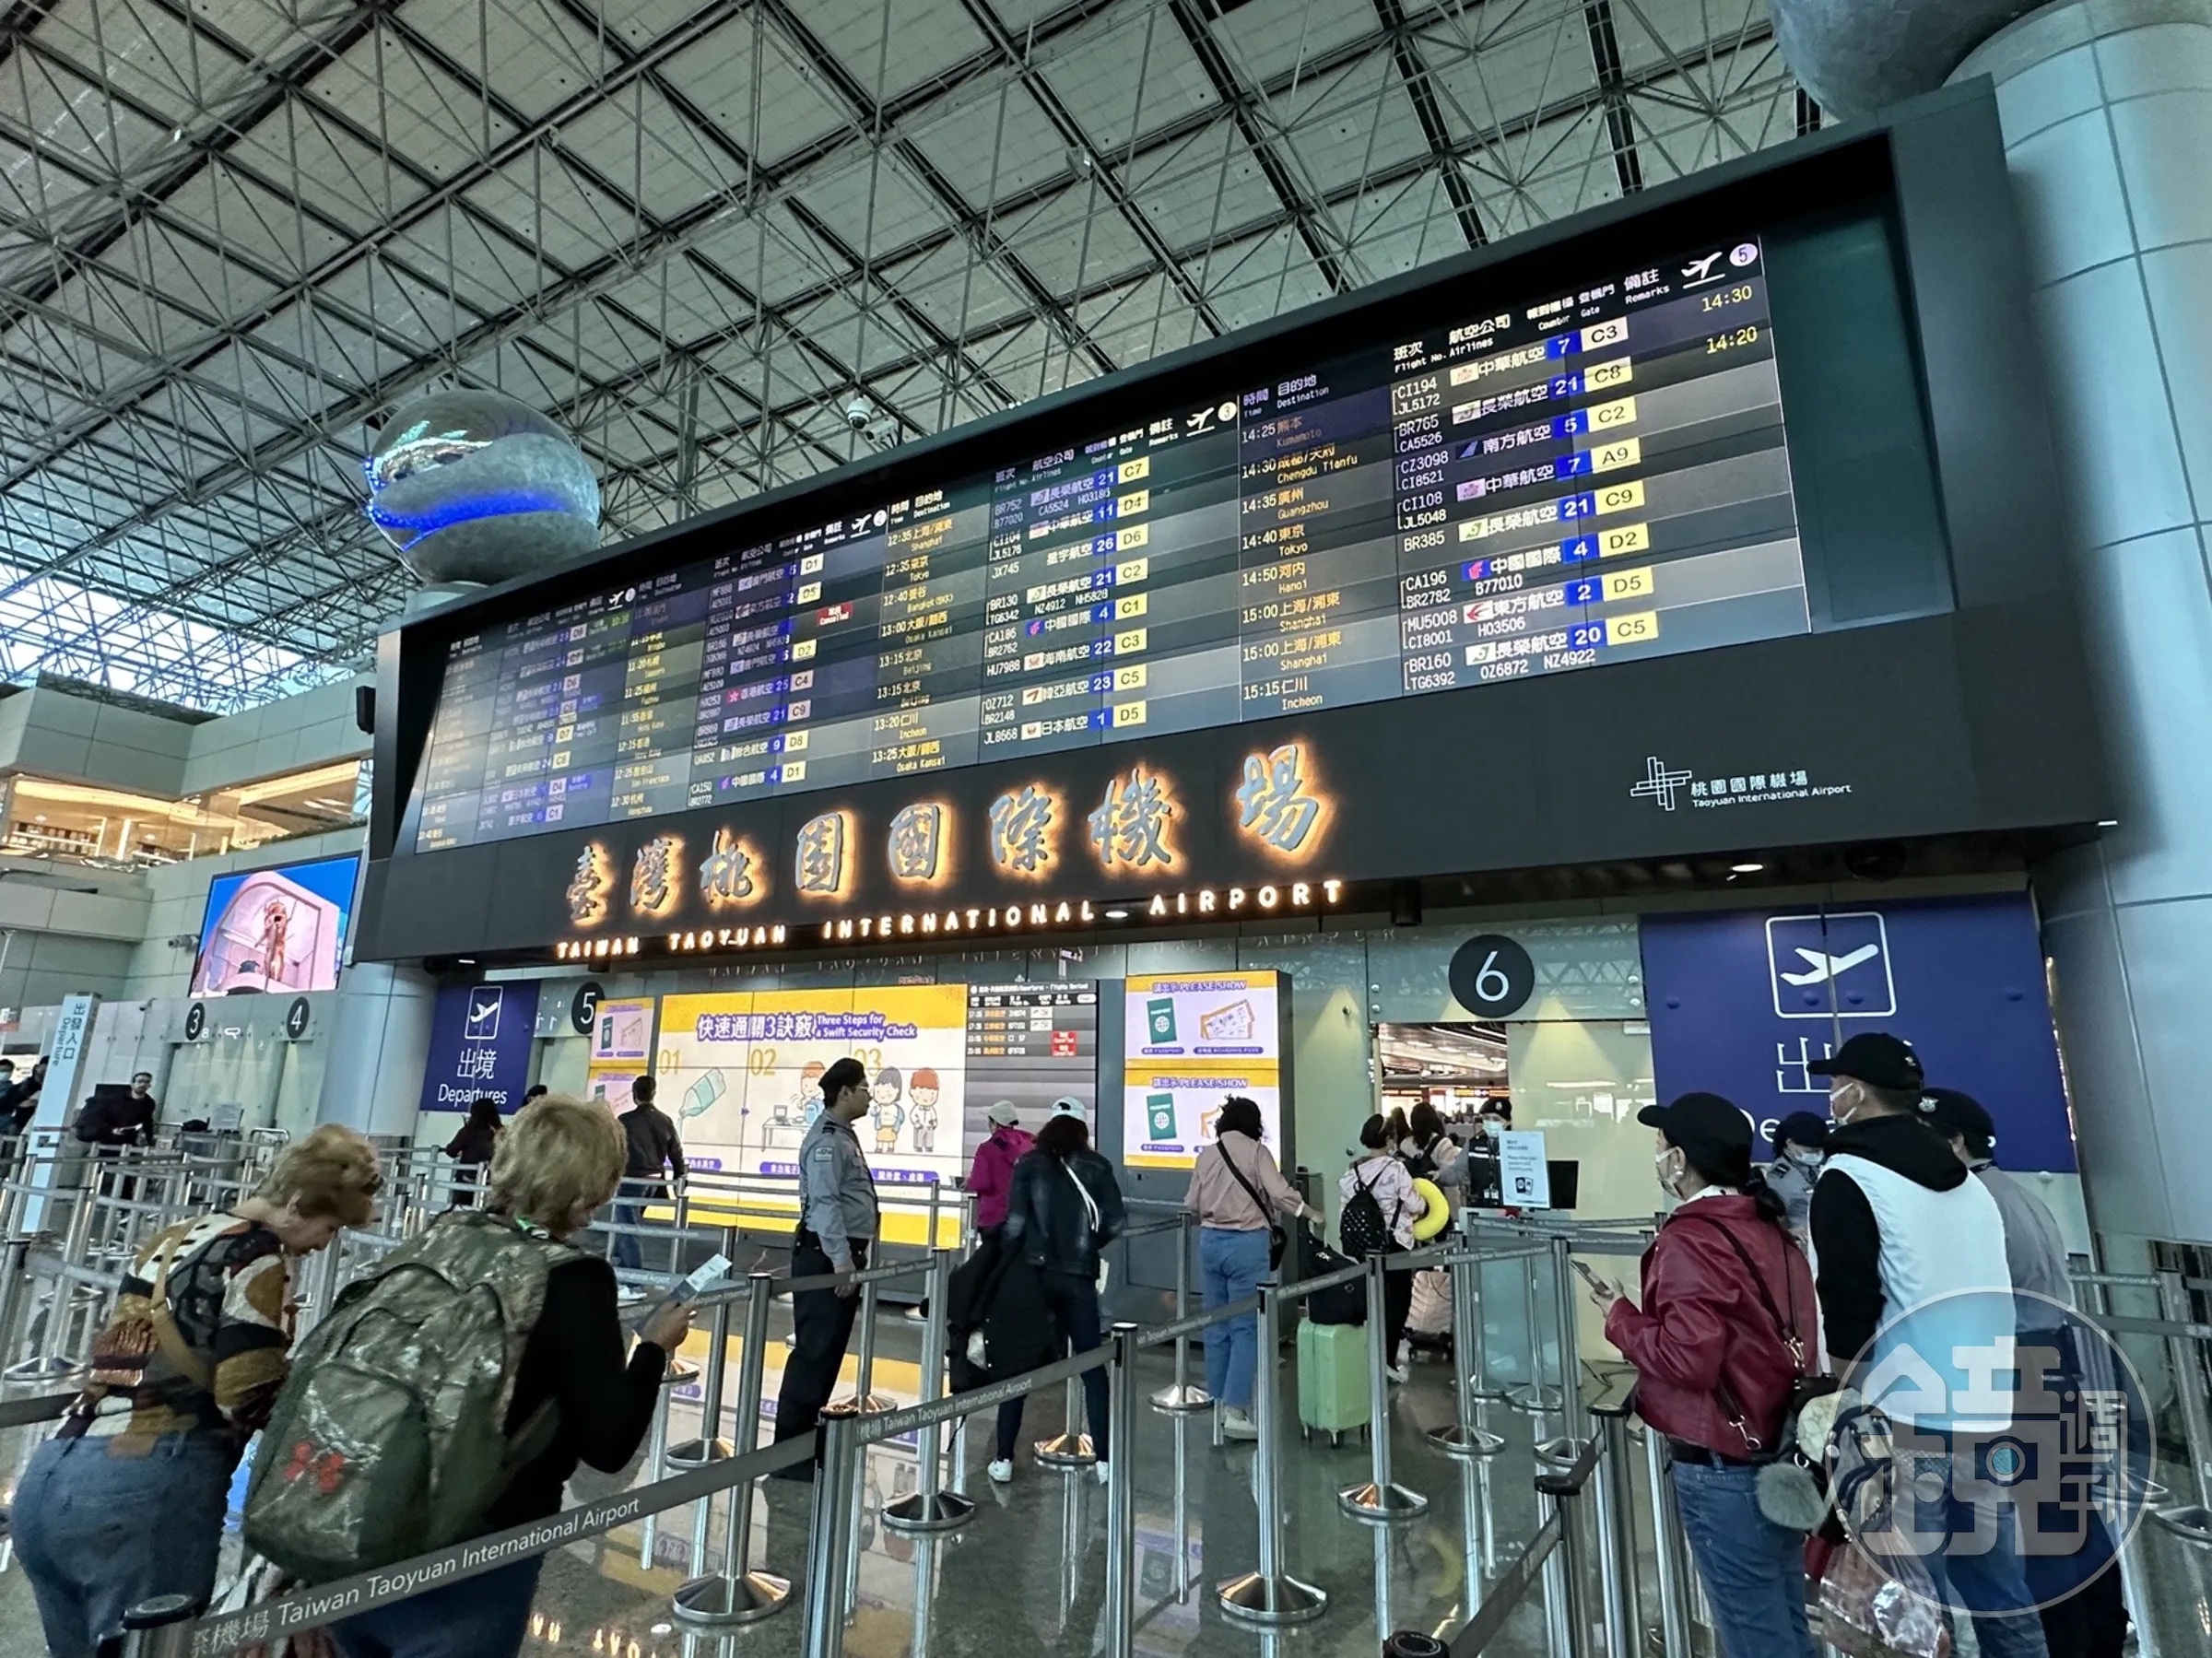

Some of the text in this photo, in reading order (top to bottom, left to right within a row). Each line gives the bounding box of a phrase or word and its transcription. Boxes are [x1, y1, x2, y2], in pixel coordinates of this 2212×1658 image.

[1394, 246, 1748, 362] 班次 航空公司 5
[1394, 284, 1670, 373] Flight Airlines Remarks
[1397, 284, 1753, 399] CI194 中華航空 7 C3 14:30
[1277, 374, 1317, 396] 目的地
[1398, 325, 1759, 437] BR765 21 C8 14:20
[1277, 386, 1329, 409] Destination
[1397, 394, 1441, 415] JL5172
[1241, 422, 1276, 443] 14:25
[1276, 428, 1322, 448] Kumamoto
[1400, 406, 1625, 474] CZ3098 南方航空 5 C2
[1400, 432, 1442, 453] CA5526
[1099, 464, 1142, 486] 21 C7
[1241, 458, 1277, 479] 14:30
[1277, 454, 1358, 484] Chengdu Tianfu
[1402, 447, 1629, 512] CI108 中華航空 7 A9
[1401, 471, 1444, 493] CI8521
[1124, 496, 1141, 510] D4
[1241, 487, 1304, 514] 14:35 廣州
[1277, 499, 1329, 520] Guangzhou
[1403, 509, 1447, 530] JL5048
[1404, 489, 1632, 553] BR385 長榮航空 21 C9
[1097, 530, 1141, 552] 26 D6
[1242, 523, 1305, 549] 14:40 東京
[1278, 542, 1308, 558] Tokyo
[1406, 531, 1638, 591] CA196 中國國際 4 D2
[806, 559, 818, 570] D1
[1096, 564, 1141, 586] 21 C2
[1242, 566, 1277, 586] 14:50
[1278, 580, 1307, 594] Hanoi
[802, 586, 817, 599] D5
[884, 589, 907, 606] 12:40
[1406, 573, 1523, 608] BR2782 B77010
[1099, 602, 1139, 618] 4 C1
[1243, 592, 1340, 624] 15:00 上海/浦東
[1407, 574, 1642, 633] MU5008 東方航空 2 D5
[882, 620, 906, 637] 13:00
[1279, 613, 1326, 633] Shanghai
[1095, 636, 1139, 654] 22 C3
[1243, 631, 1342, 662] 15:00 上海/浦東
[1408, 629, 1453, 650] CI8001
[1409, 619, 1646, 674] BR160 長榮航空 20 C5
[798, 645, 811, 657] D2
[879, 652, 903, 667] 13:15
[1280, 652, 1328, 671] Shanghai
[1094, 671, 1139, 690] 23 C5
[1411, 648, 1595, 691] TG6392 NZ4922
[776, 676, 808, 692] 25 C4
[877, 683, 901, 699] 13:15
[1243, 676, 1309, 700] 15:15 仁川
[793, 706, 806, 717] C9
[1282, 694, 1324, 711] Incheon
[875, 715, 900, 731] 13:20
[1121, 707, 1139, 721] D5
[773, 735, 803, 750] 9 D8
[872, 747, 898, 763] 13:25
[921, 755, 946, 770] Kansai
[771, 767, 800, 781] 4 D1
[1690, 770, 1808, 797] 桃園國際機場
[1692, 784, 1852, 808] Taoyuan International Airport
[566, 744, 1319, 922] 臺灣桃園國際機場
[557, 880, 1342, 959] TAIWAN TAOYUAN INTERNATIONAL AIRPORT
[1180, 982, 1217, 992] PLEASE
[1217, 980, 1246, 991] SHOW
[1475, 950, 1510, 1003] 6
[291, 1008, 302, 1030] 4
[581, 992, 595, 1025] 5
[63, 1003, 86, 1060] 出發入口
[190, 1009, 200, 1033] 3
[698, 1013, 813, 1041] 快速通關3訣竅
[817, 1015, 882, 1027] Three Steps for
[53, 1017, 71, 1066] Departure
[823, 1026, 845, 1038] Swift
[847, 1026, 885, 1041] Security
[887, 1026, 915, 1037] Check
[457, 1049, 496, 1080] 出境
[660, 1048, 882, 1076] 01 02 03
[1180, 1077, 1217, 1088] PLEASE
[1218, 1076, 1248, 1088] SHOW
[438, 1083, 508, 1108] Departures
[883, 1378, 1032, 1431] Taiwan Taoyuan International Airport
[277, 1497, 641, 1627] Taiwan Taoyuan International Airport
